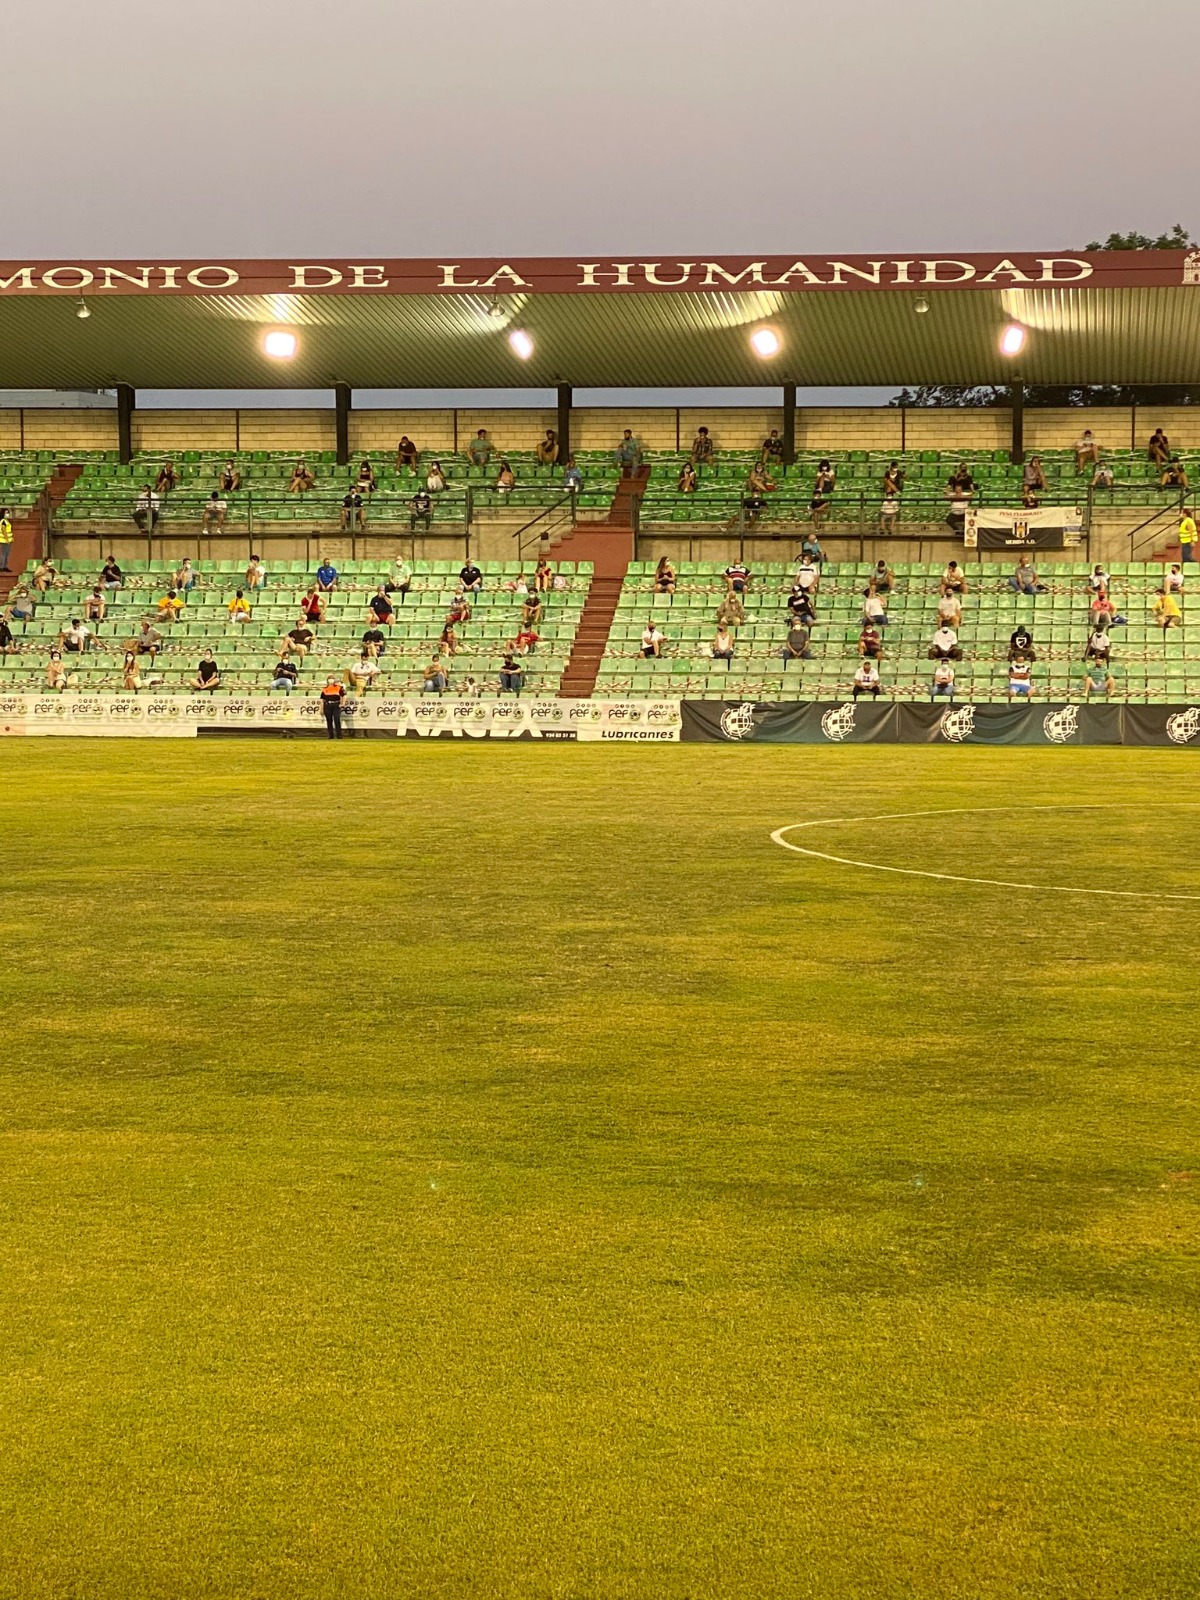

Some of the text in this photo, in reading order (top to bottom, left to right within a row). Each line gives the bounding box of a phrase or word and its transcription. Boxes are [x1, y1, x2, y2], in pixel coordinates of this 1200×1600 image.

[288, 265, 389, 288] DE
[437, 264, 533, 287] LA
[577, 258, 1094, 286] HUMANIDAD
